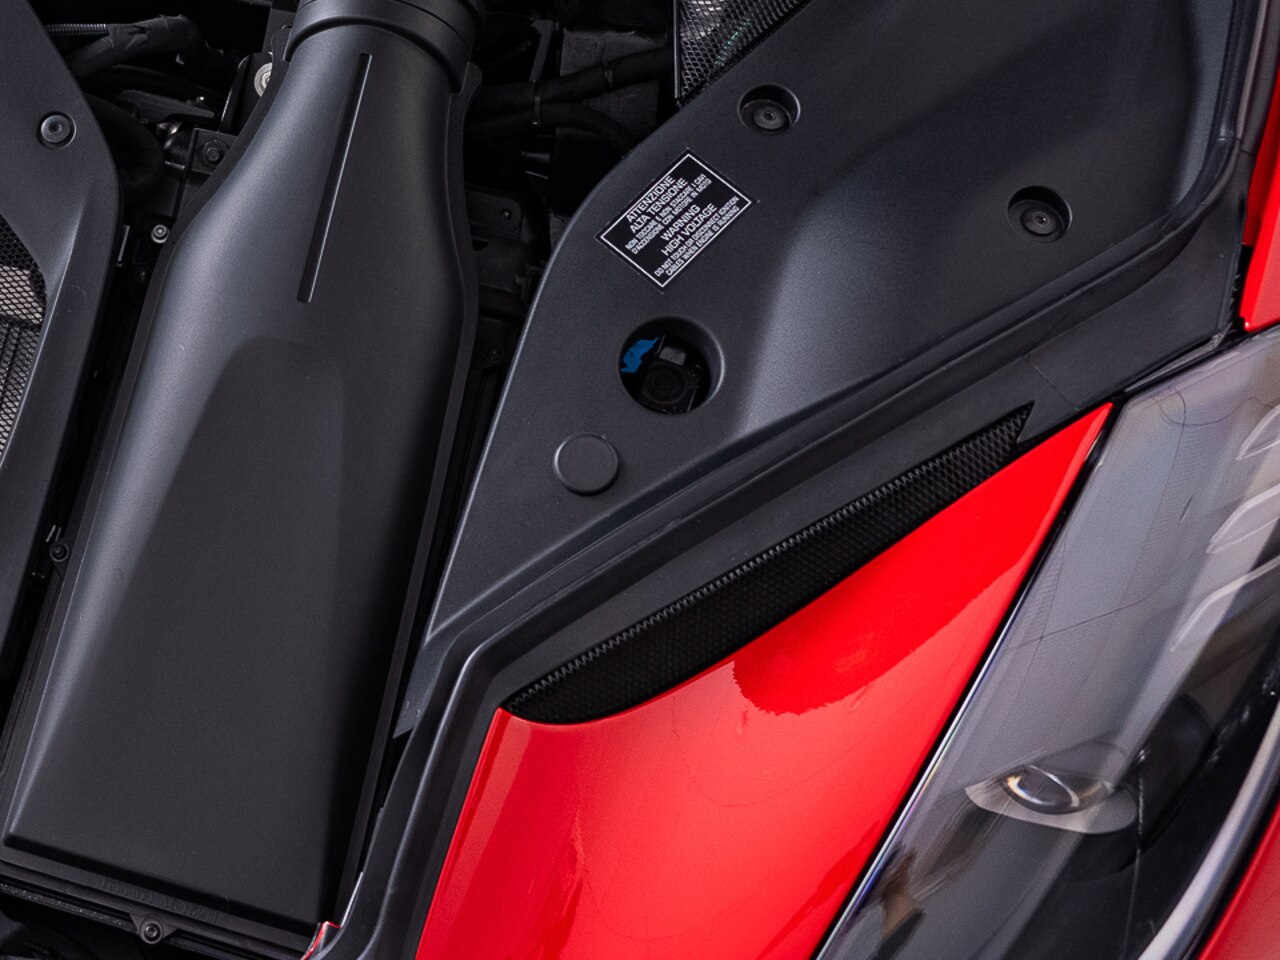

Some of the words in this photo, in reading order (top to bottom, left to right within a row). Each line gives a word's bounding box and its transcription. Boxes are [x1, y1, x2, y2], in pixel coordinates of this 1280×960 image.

[624, 175, 675, 223] ATTENZIONE
[628, 213, 650, 233] ALTA
[646, 177, 688, 216] TENSIONE
[659, 203, 701, 242] WARNING
[661, 213, 674, 225] CON
[624, 237, 638, 250] NON
[658, 205, 672, 217] NON
[660, 234, 685, 256] HIGH
[680, 203, 717, 237] VOLTAGE
[660, 258, 673, 269] NOT
[670, 244, 688, 261] TOUCH
[691, 212, 721, 240] DISCONNECT
[717, 195, 739, 215] IGNITION
[664, 257, 684, 276] CABLES
[681, 244, 698, 260] WHEN
[694, 229, 714, 247] ENGINE
[716, 204, 740, 226] RUNNING
